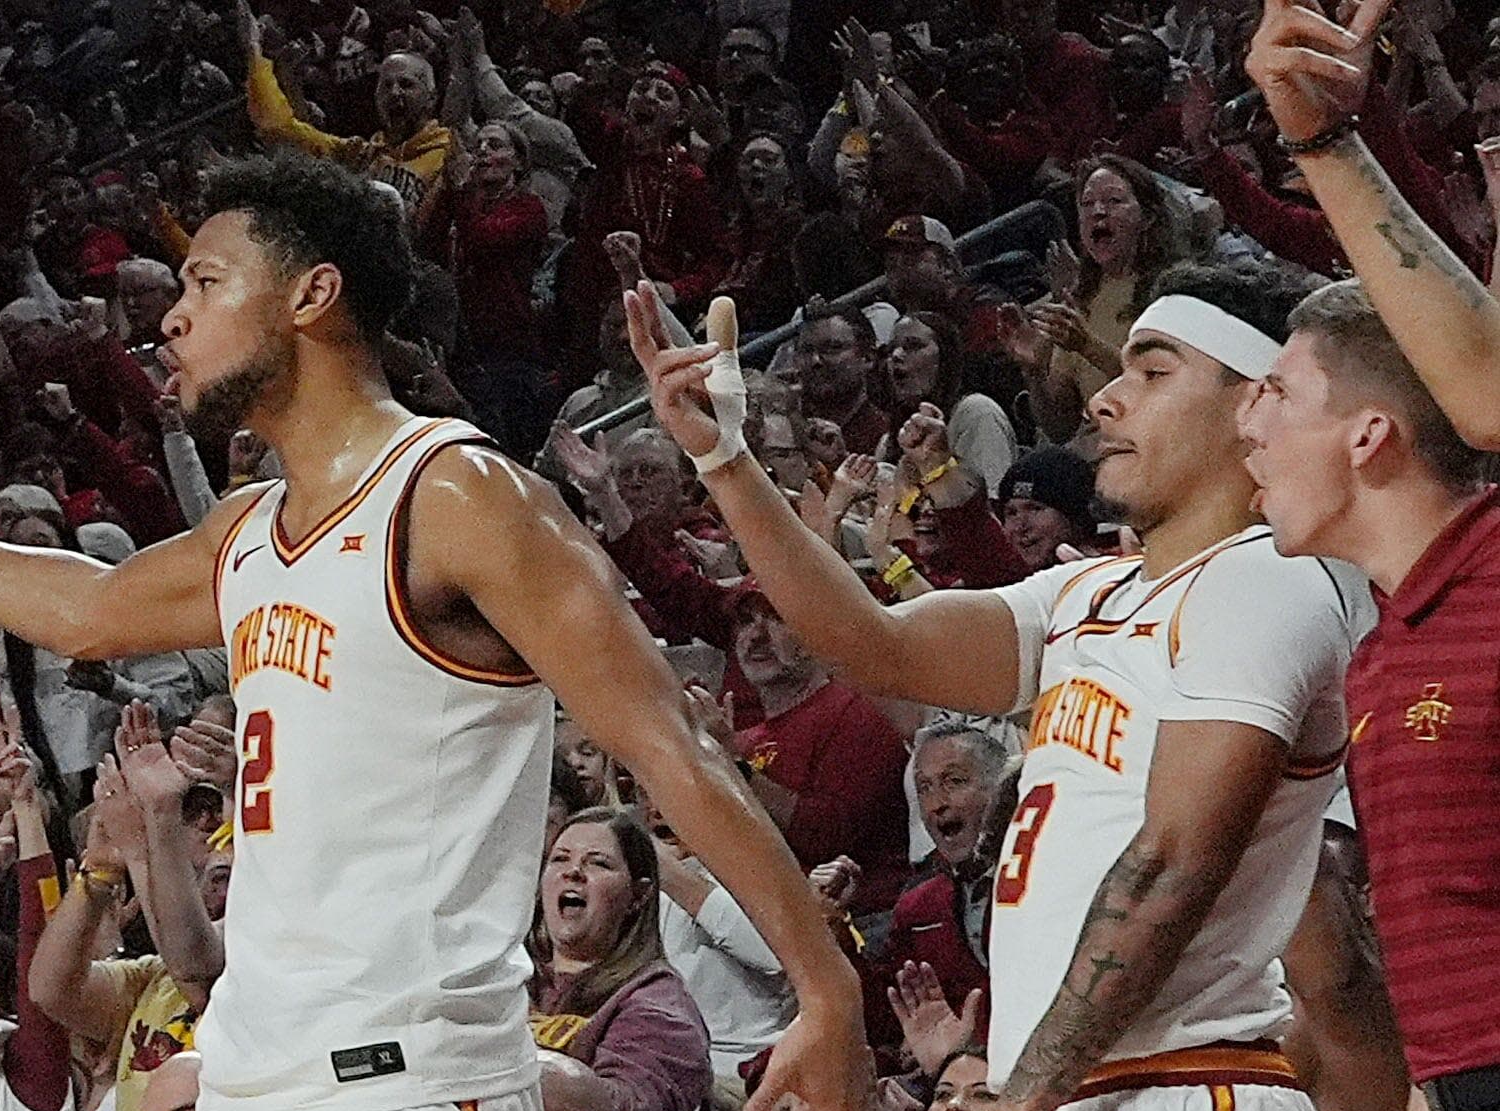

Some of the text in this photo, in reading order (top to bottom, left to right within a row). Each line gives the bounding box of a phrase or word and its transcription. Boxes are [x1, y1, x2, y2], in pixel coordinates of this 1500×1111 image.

[261, 602, 338, 693] STATE
[241, 707, 276, 837] 2
[1049, 676, 1134, 776] STATE
[995, 781, 1058, 908] 3
